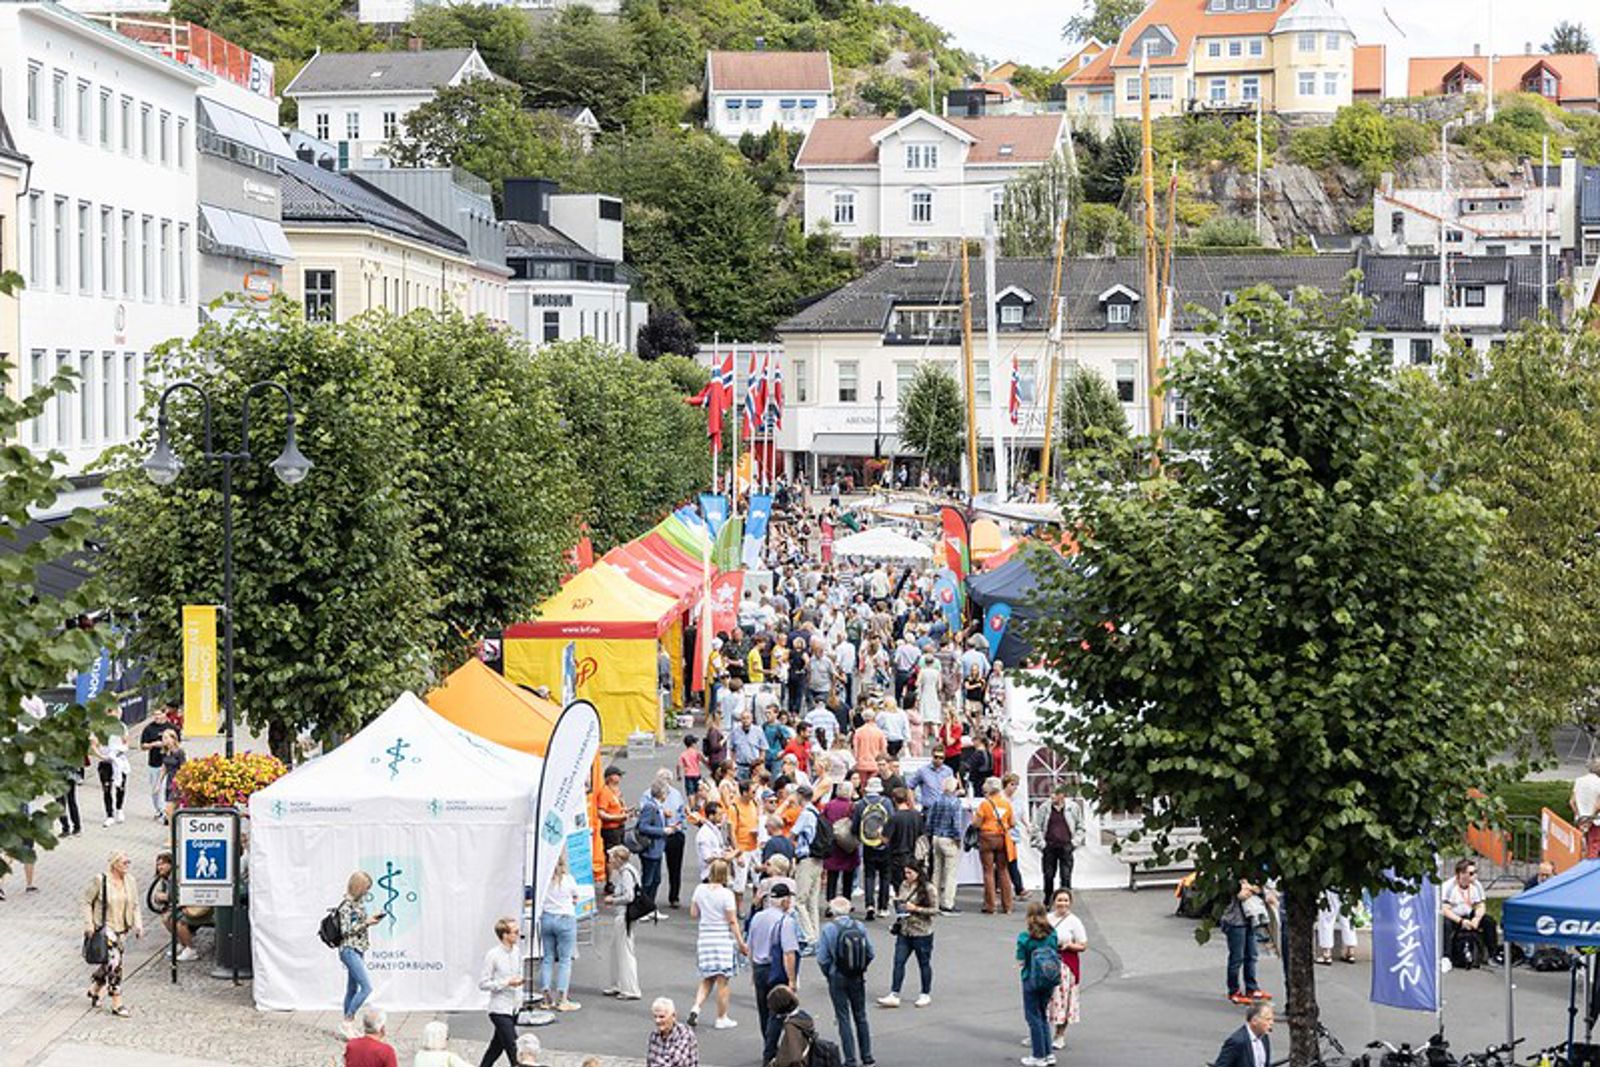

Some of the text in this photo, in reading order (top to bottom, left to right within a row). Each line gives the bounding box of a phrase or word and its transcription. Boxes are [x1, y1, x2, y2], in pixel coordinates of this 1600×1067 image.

[189, 819, 225, 833] Sone
[372, 949, 408, 959] NORSK
[367, 961, 443, 971] OPATFORBUND
